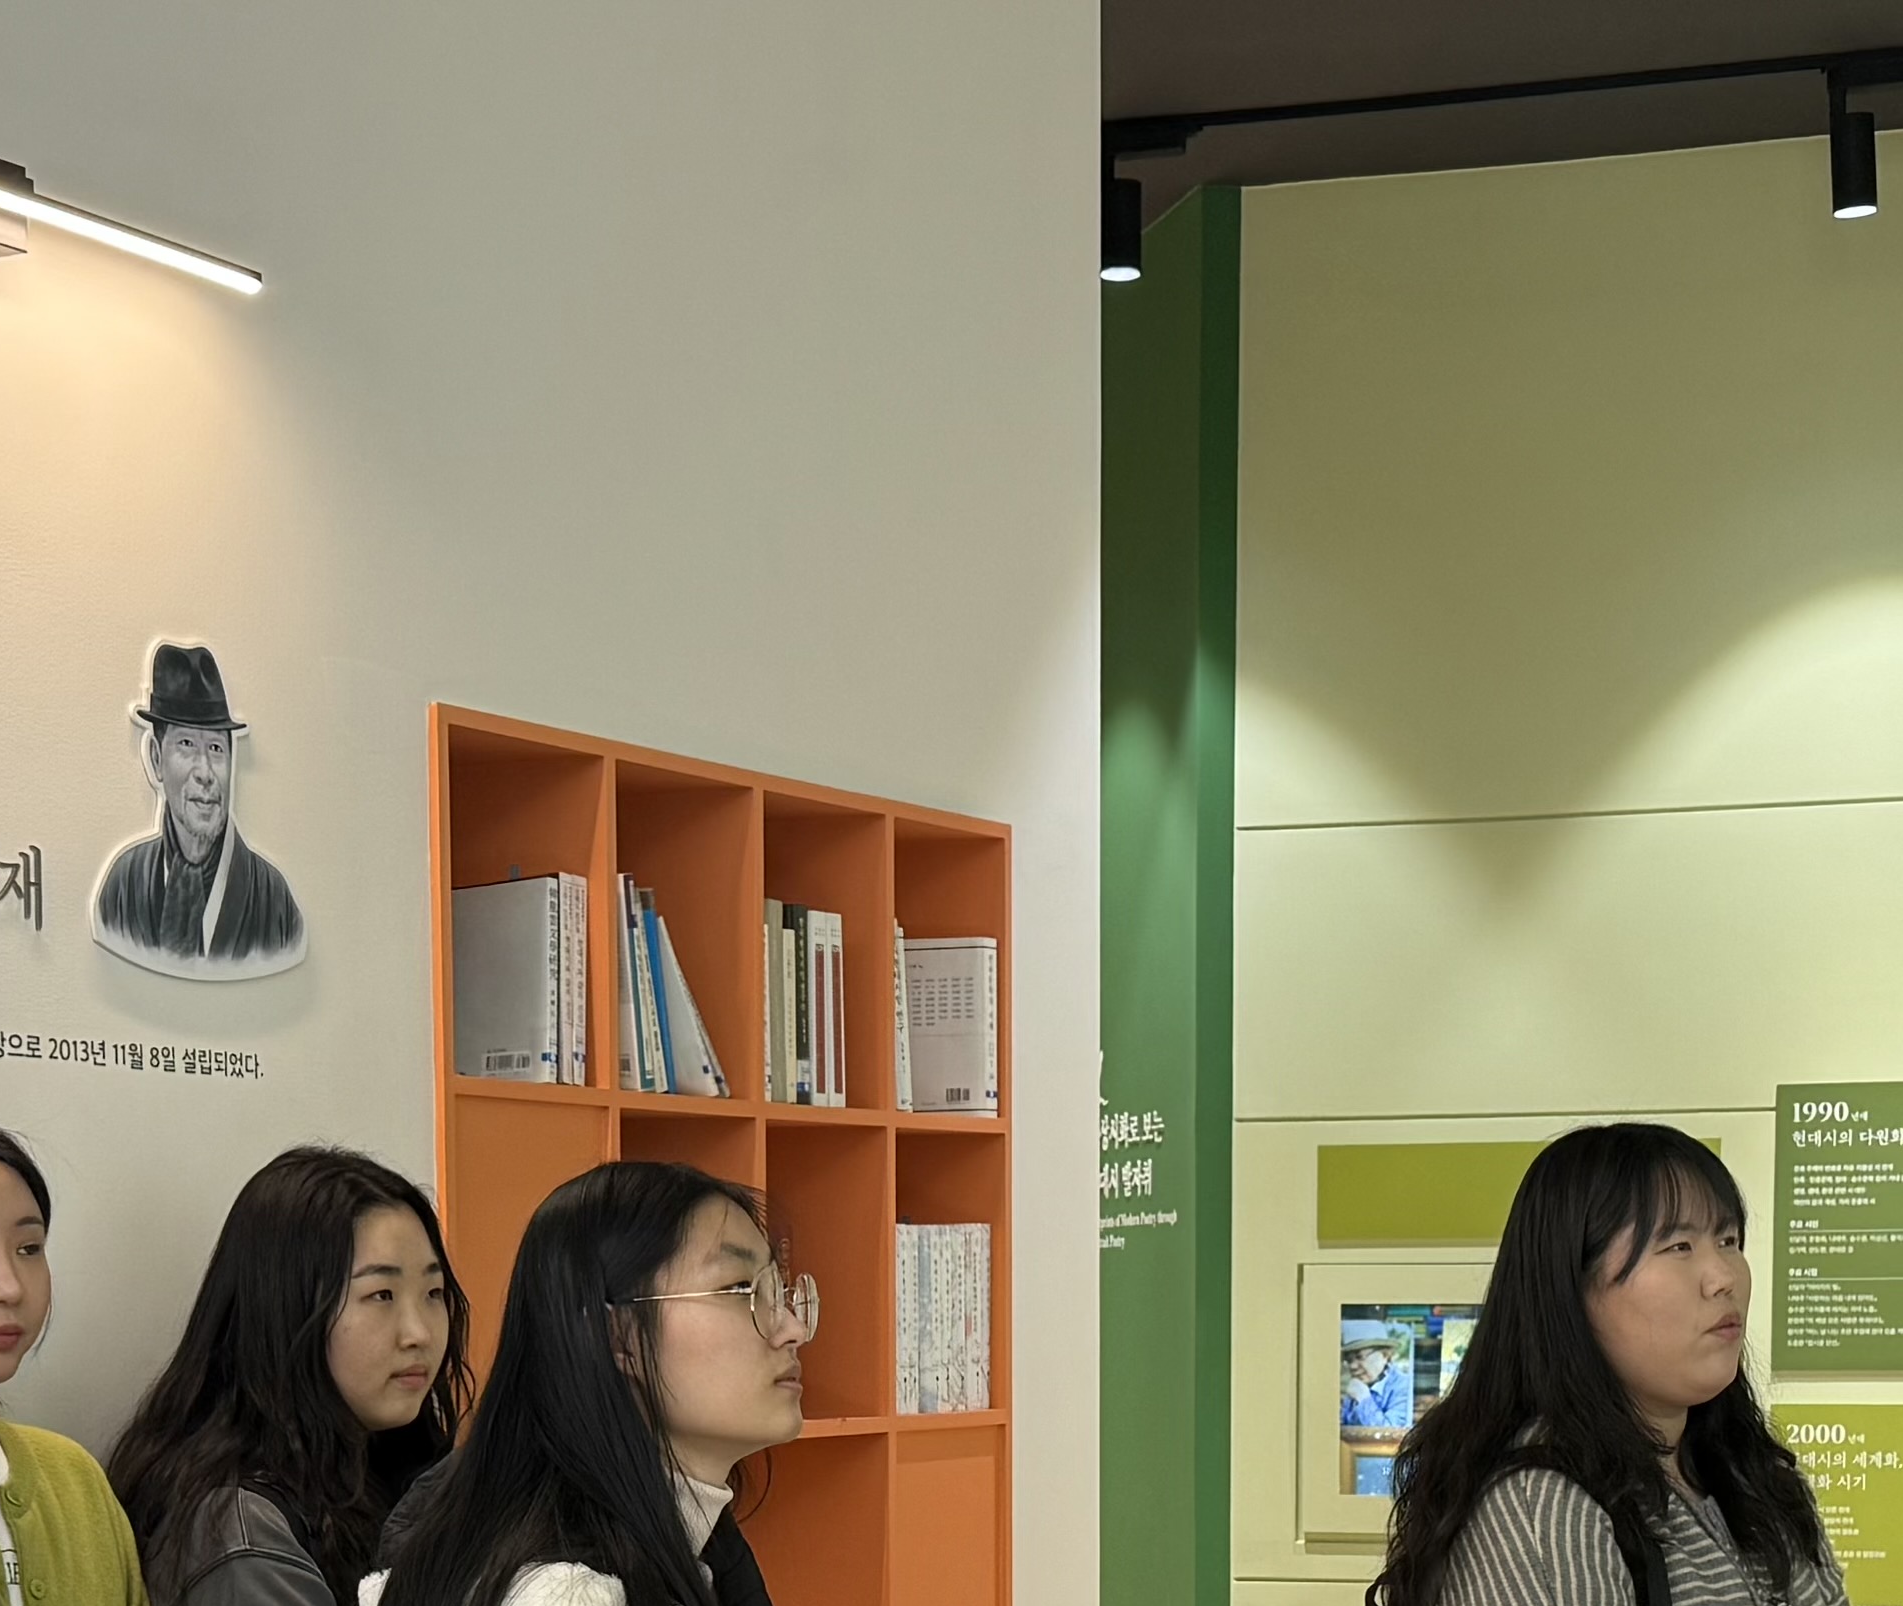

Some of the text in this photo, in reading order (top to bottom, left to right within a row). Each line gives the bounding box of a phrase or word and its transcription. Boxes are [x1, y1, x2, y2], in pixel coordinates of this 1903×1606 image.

[48, 1037, 107, 1067] 2013년
[111, 1042, 144, 1071] 11월
[149, 1045, 177, 1073] 8일
[181, 1050, 265, 1079] 설립되었다.
[1792, 1128, 1853, 1148] 현대시의
[1796, 1451, 1847, 1469] 대시의
[1836, 1473, 1867, 1491] 시기
